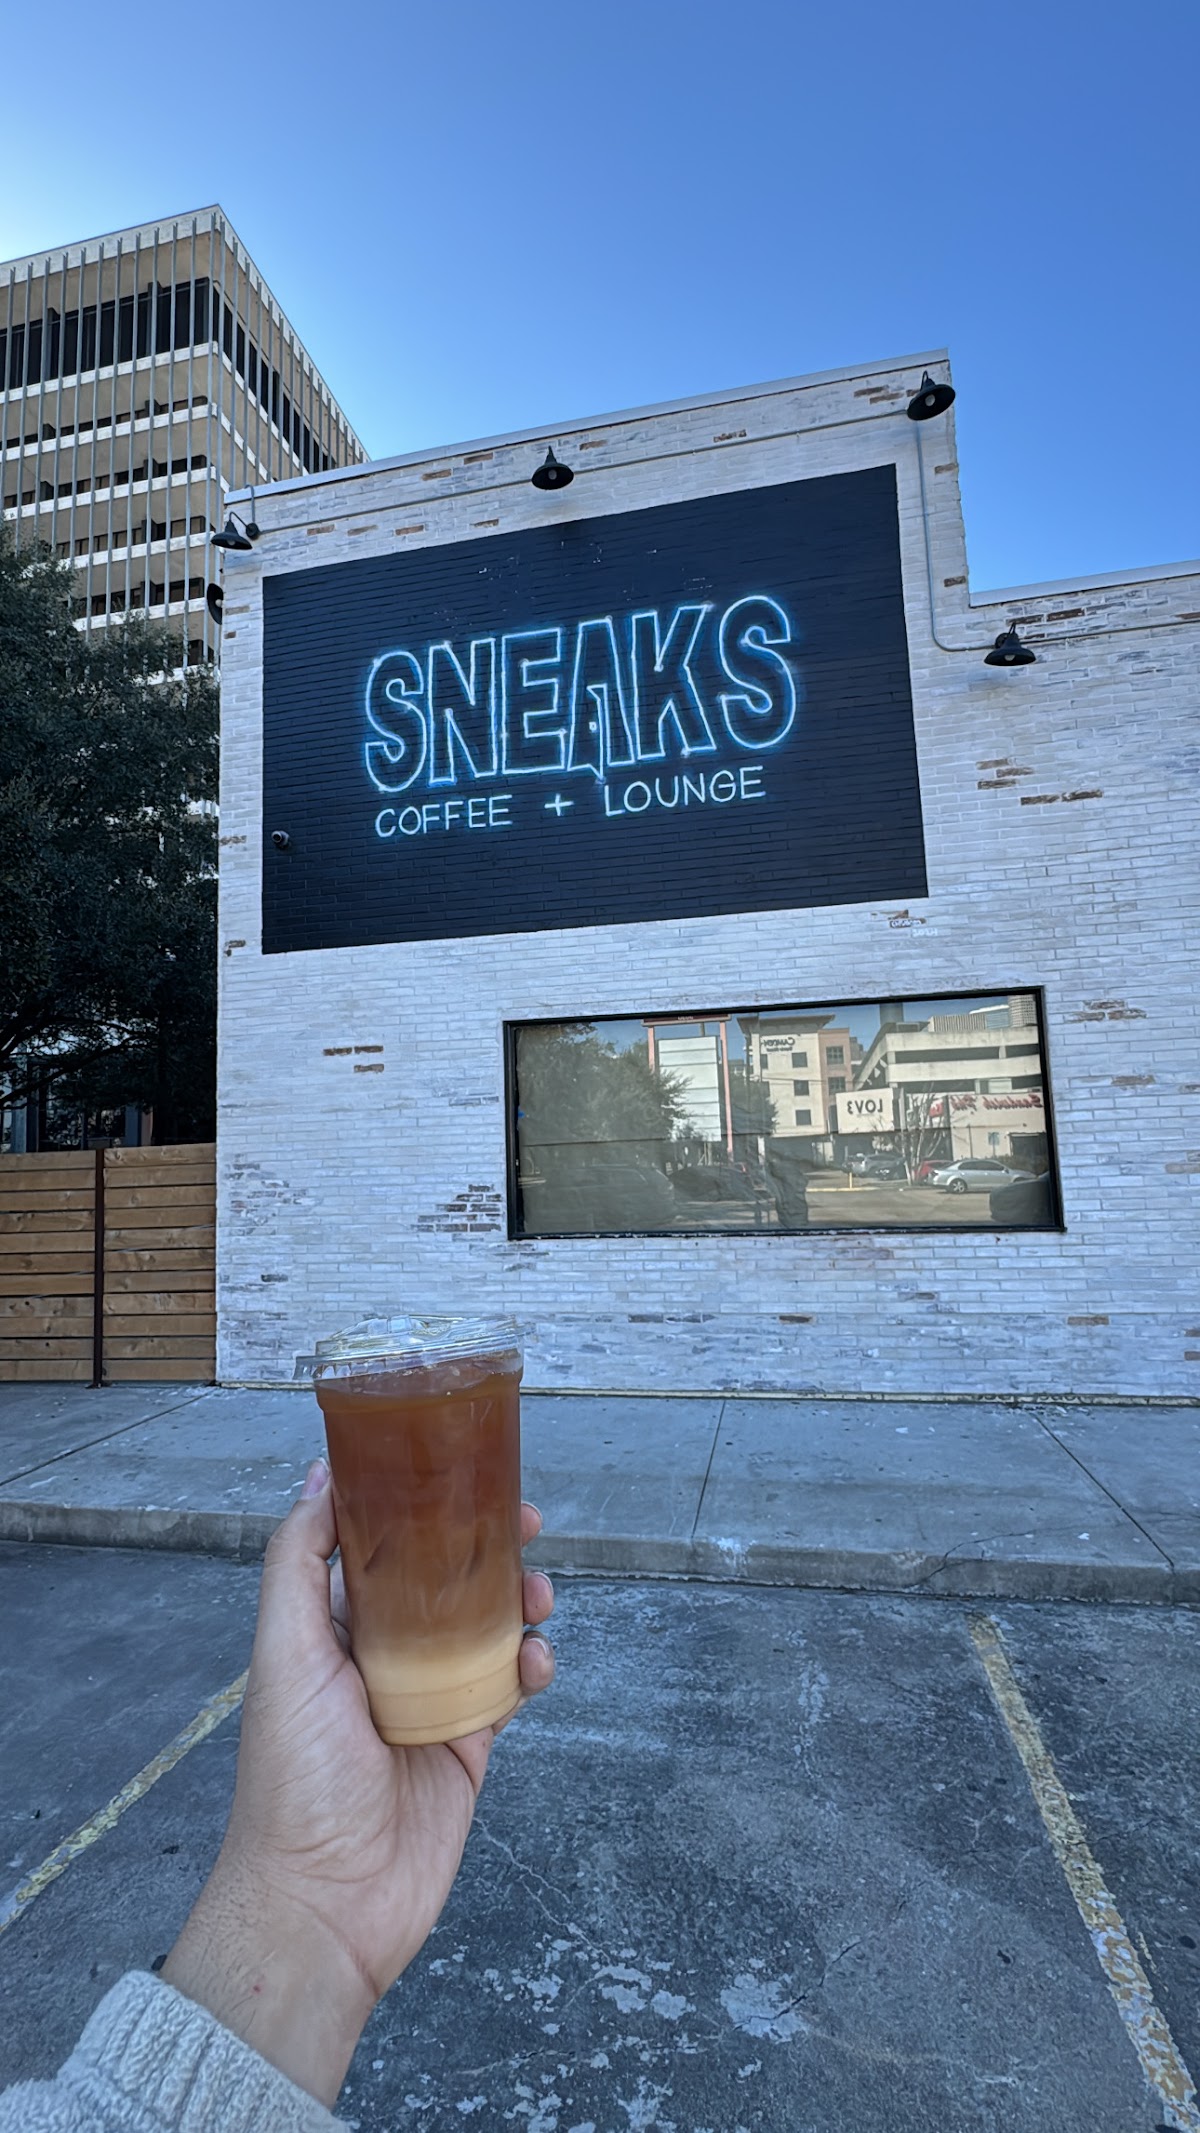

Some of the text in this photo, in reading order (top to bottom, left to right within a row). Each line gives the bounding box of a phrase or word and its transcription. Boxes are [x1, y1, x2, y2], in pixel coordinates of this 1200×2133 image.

[364, 594, 797, 793] SNEAKS
[374, 764, 767, 838] COFFEE + LOUNGE
